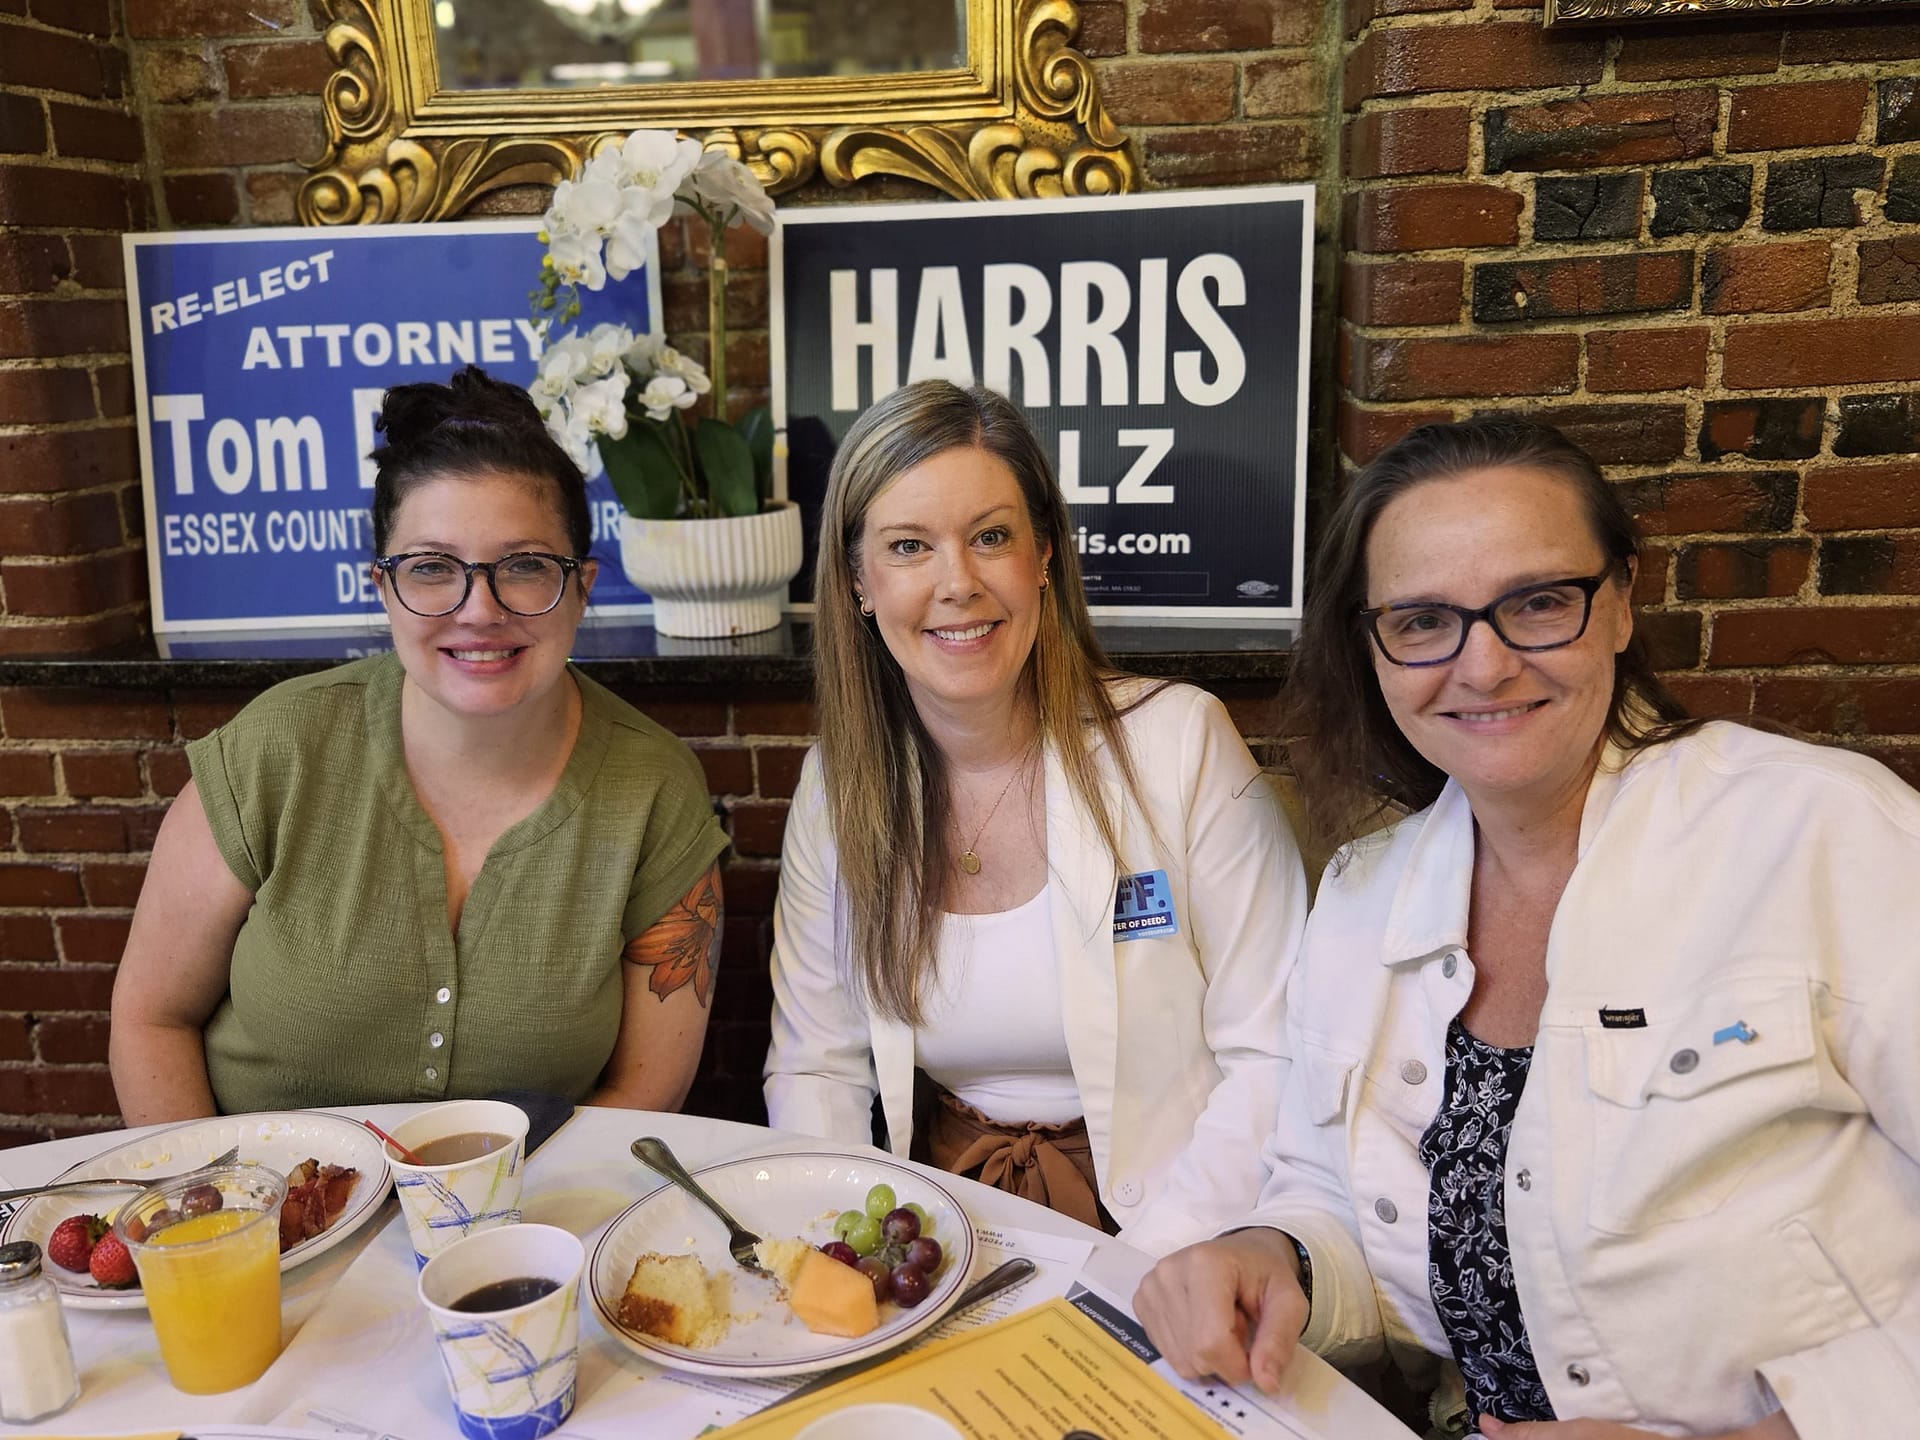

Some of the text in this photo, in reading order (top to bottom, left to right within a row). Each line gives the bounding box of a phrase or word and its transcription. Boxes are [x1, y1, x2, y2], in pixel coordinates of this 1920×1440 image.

[150, 250, 334, 334] RE-ELECT
[242, 318, 552, 370] ATTORNEY
[829, 253, 1246, 411] HARRIS
[152, 394, 327, 495] Tom
[1059, 428, 1174, 504] LZ
[164, 512, 259, 556] ESSEX
[1070, 526, 1191, 554] is.com
[1113, 916, 1167, 931] TER OF DEEDS
[1075, 1301, 1154, 1357] State Representative
